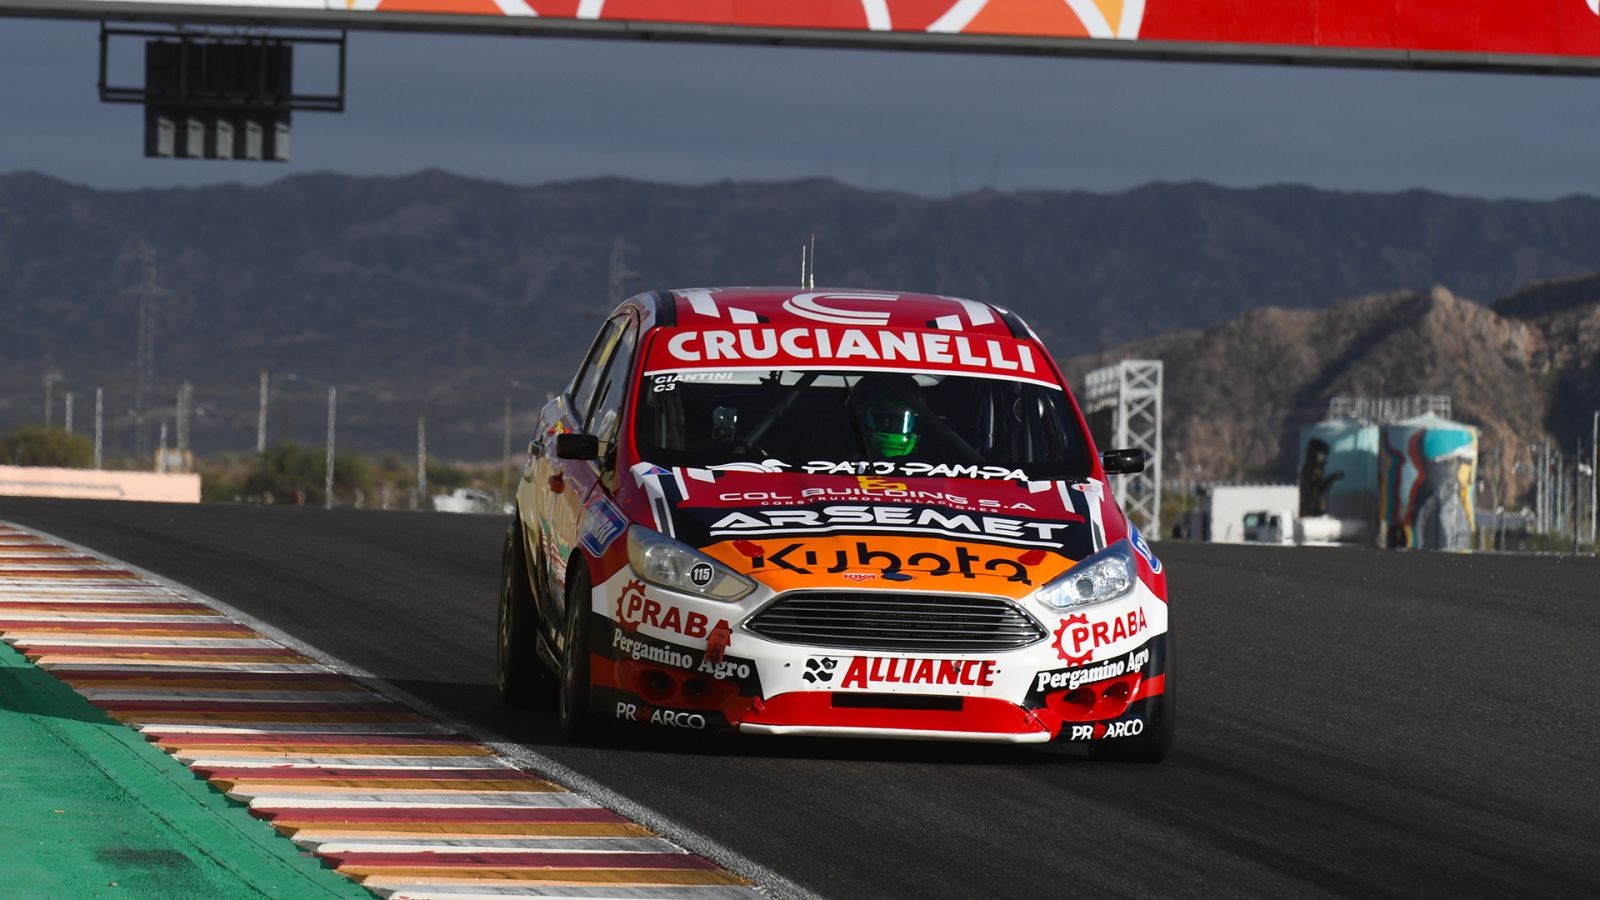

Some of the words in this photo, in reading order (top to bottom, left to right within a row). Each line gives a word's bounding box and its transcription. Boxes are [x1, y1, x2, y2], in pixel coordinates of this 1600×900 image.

[667, 328, 1036, 374] CRUCIANELLI
[653, 383, 676, 393] C3
[654, 372, 734, 384] CIANTINI
[899, 462, 1029, 482] PAMPA
[719, 491, 793, 501] COL
[801, 487, 969, 505] BUILDING
[761, 496, 881, 506] CONSTRUIMOS
[893, 498, 999, 513] RELACIONES
[710, 505, 1069, 540] ARSEMET
[693, 568, 711, 581] 115
[751, 541, 1033, 587] Kubota
[627, 593, 731, 647] PRABA
[1071, 606, 1148, 653] PRABA
[612, 627, 694, 669] Pergamino
[840, 655, 997, 689] ALLIANCE
[1036, 660, 1125, 692] Pergamino
[1126, 648, 1150, 673] Agro
[615, 701, 706, 730] PRARCO
[1071, 718, 1144, 741] PRARCO
